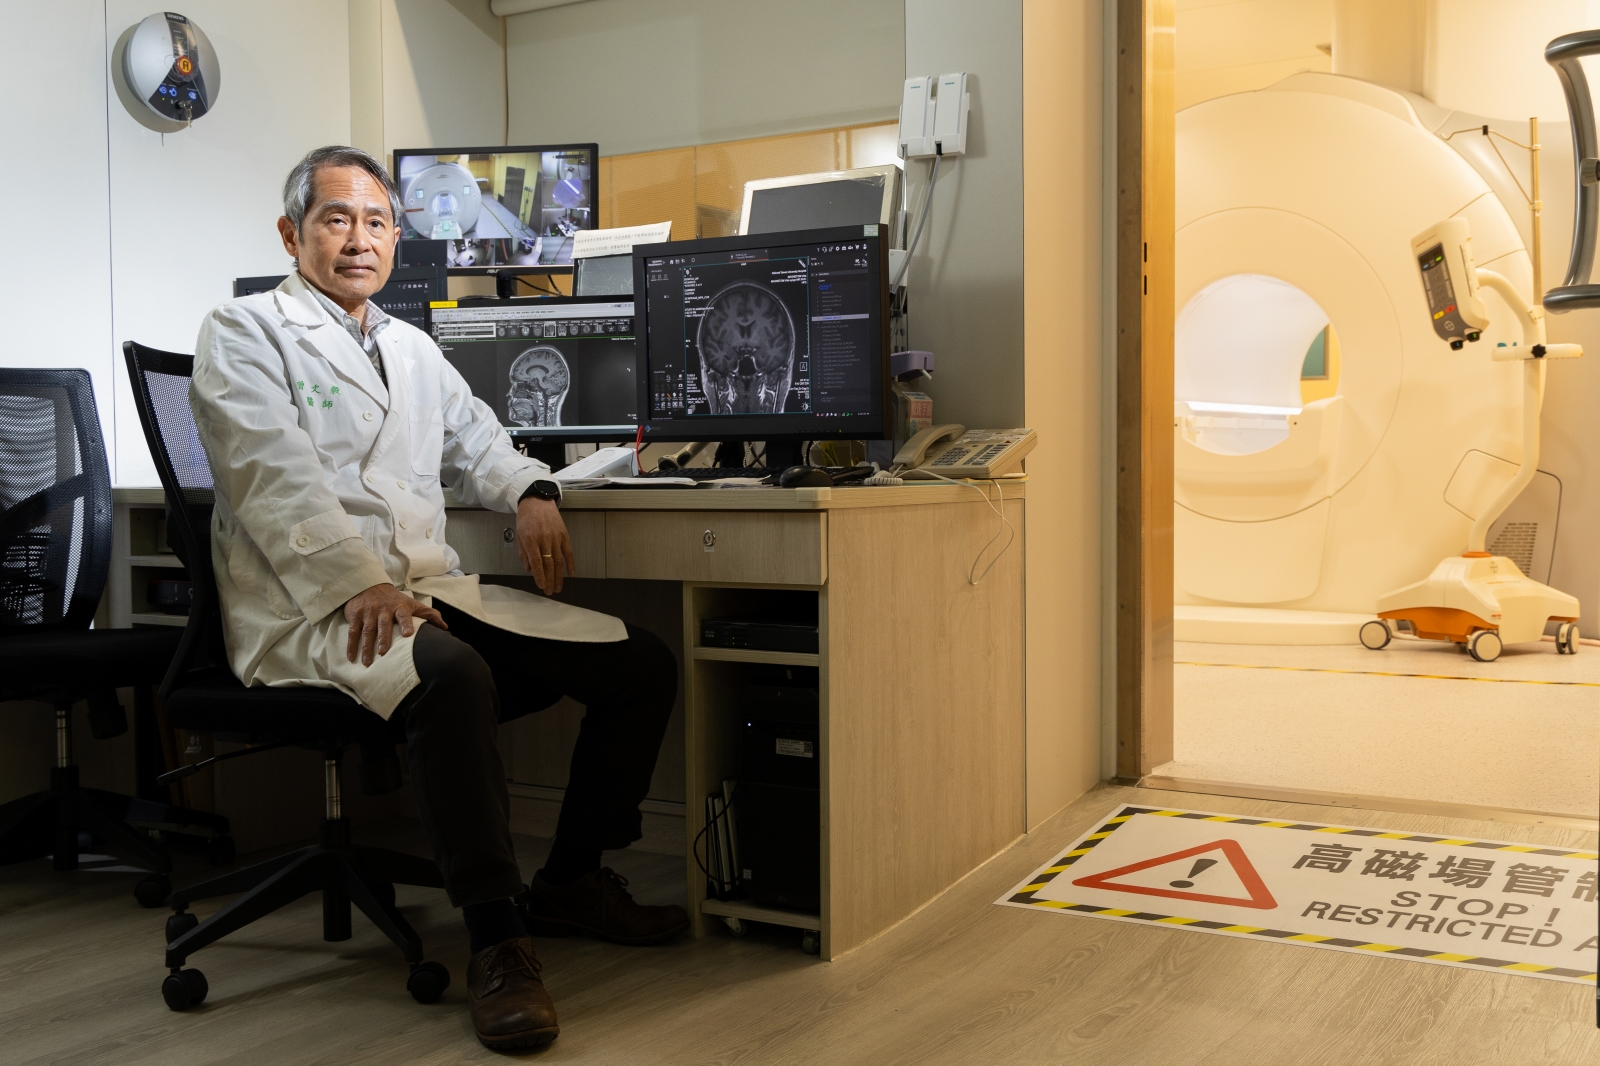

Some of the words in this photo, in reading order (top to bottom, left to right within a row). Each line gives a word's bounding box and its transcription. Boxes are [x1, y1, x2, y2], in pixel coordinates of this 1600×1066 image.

[167, 13, 184, 21] SIEMENS
[306, 396, 333, 410] 醫師
[1301, 900, 1562, 948] RESTRICTED
